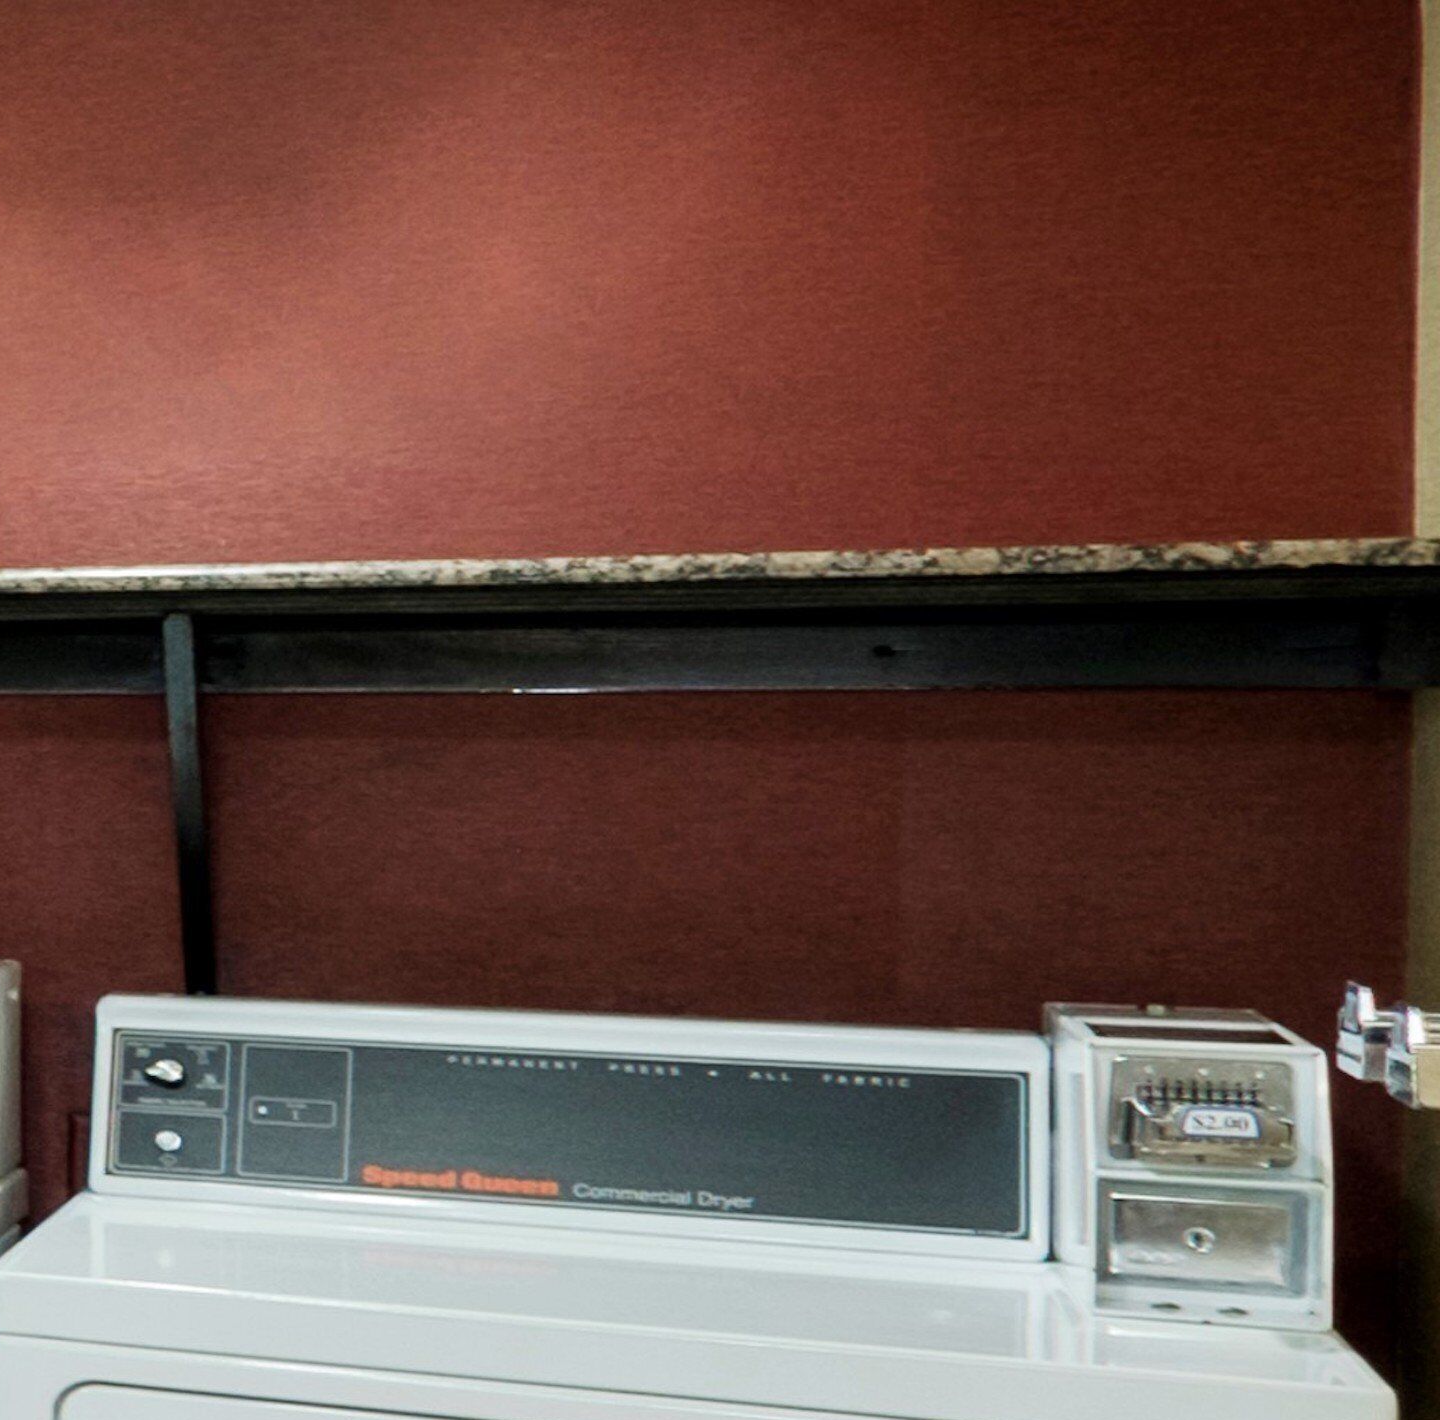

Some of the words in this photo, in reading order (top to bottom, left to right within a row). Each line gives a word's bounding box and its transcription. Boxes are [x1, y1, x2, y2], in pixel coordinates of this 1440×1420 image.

[362, 1163, 458, 1189] Speed
[460, 1170, 560, 1197] Queen
[572, 1181, 692, 1206] Commercial
[697, 1190, 754, 1211] Dryer
